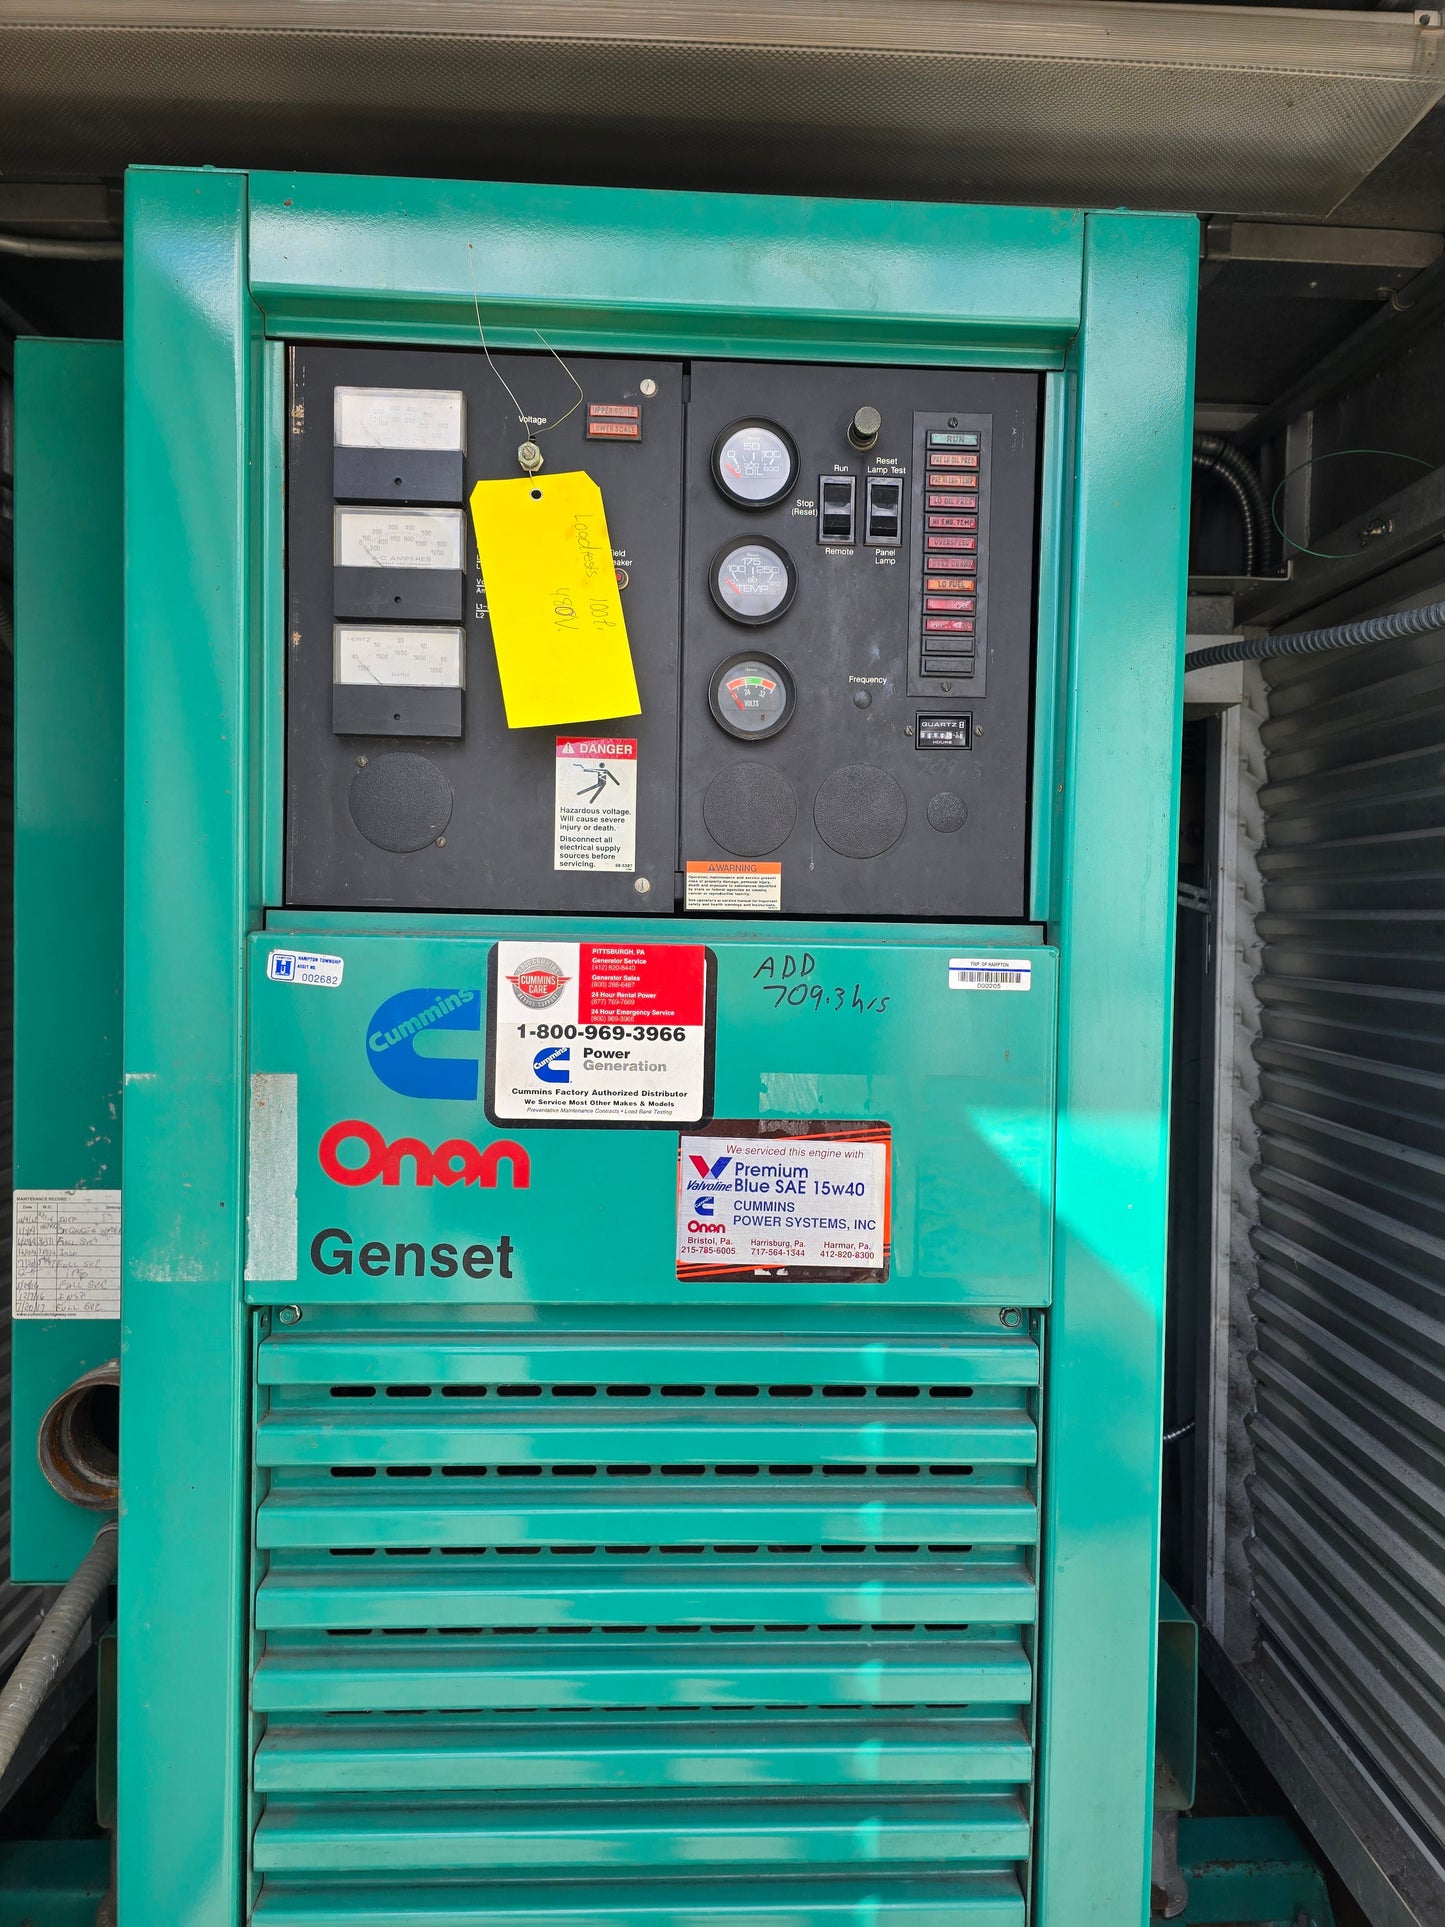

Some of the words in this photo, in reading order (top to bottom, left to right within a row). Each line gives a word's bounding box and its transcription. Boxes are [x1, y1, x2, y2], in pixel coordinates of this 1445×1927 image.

[518, 415, 547, 425] Voltage
[727, 450, 736, 458] 0
[792, 508, 818, 516] (Reset)
[849, 676, 887, 685] Frequency
[580, 743, 633, 754] DANGER
[560, 807, 600, 815] Hazardous
[602, 808, 631, 816] voltage.
[753, 952, 815, 979] ADD
[302, 974, 338, 984] 002682
[521, 975, 556, 985] CUMMINS
[529, 985, 547, 993] CARE
[763, 983, 845, 1011] 709.3
[852, 984, 890, 1013] hrs
[369, 989, 474, 1052] Cummins
[517, 1024, 686, 1042] 1-800-969-3966
[534, 1046, 568, 1070] Cummins
[583, 1048, 630, 1058] Power
[583, 1060, 667, 1072] Generation
[318, 1119, 531, 1189] Onan
[726, 1145, 742, 1154] We
[745, 1146, 786, 1156] serviced
[789, 1148, 805, 1156] this
[809, 1149, 841, 1159] engine
[844, 1150, 864, 1158] with
[736, 1162, 808, 1178] Premium
[686, 1180, 732, 1192] Valvoline
[734, 1178, 770, 1193] Blue
[775, 1180, 805, 1194] SAE
[814, 1181, 864, 1196] 15w40
[734, 1200, 794, 1212] CUMMINS
[688, 1220, 726, 1234] Onan
[734, 1216, 781, 1227] POWER
[786, 1217, 849, 1231] SYSTEMS,
[854, 1220, 876, 1230] INC
[687, 1237, 717, 1245] Bristol,
[751, 1239, 792, 1248] Harrisburg,
[824, 1242, 856, 1250] Harmar,
[310, 1228, 514, 1278] Genset
[681, 1246, 736, 1255] 215-785-6005
[751, 1248, 805, 1256] 717-564-1344
